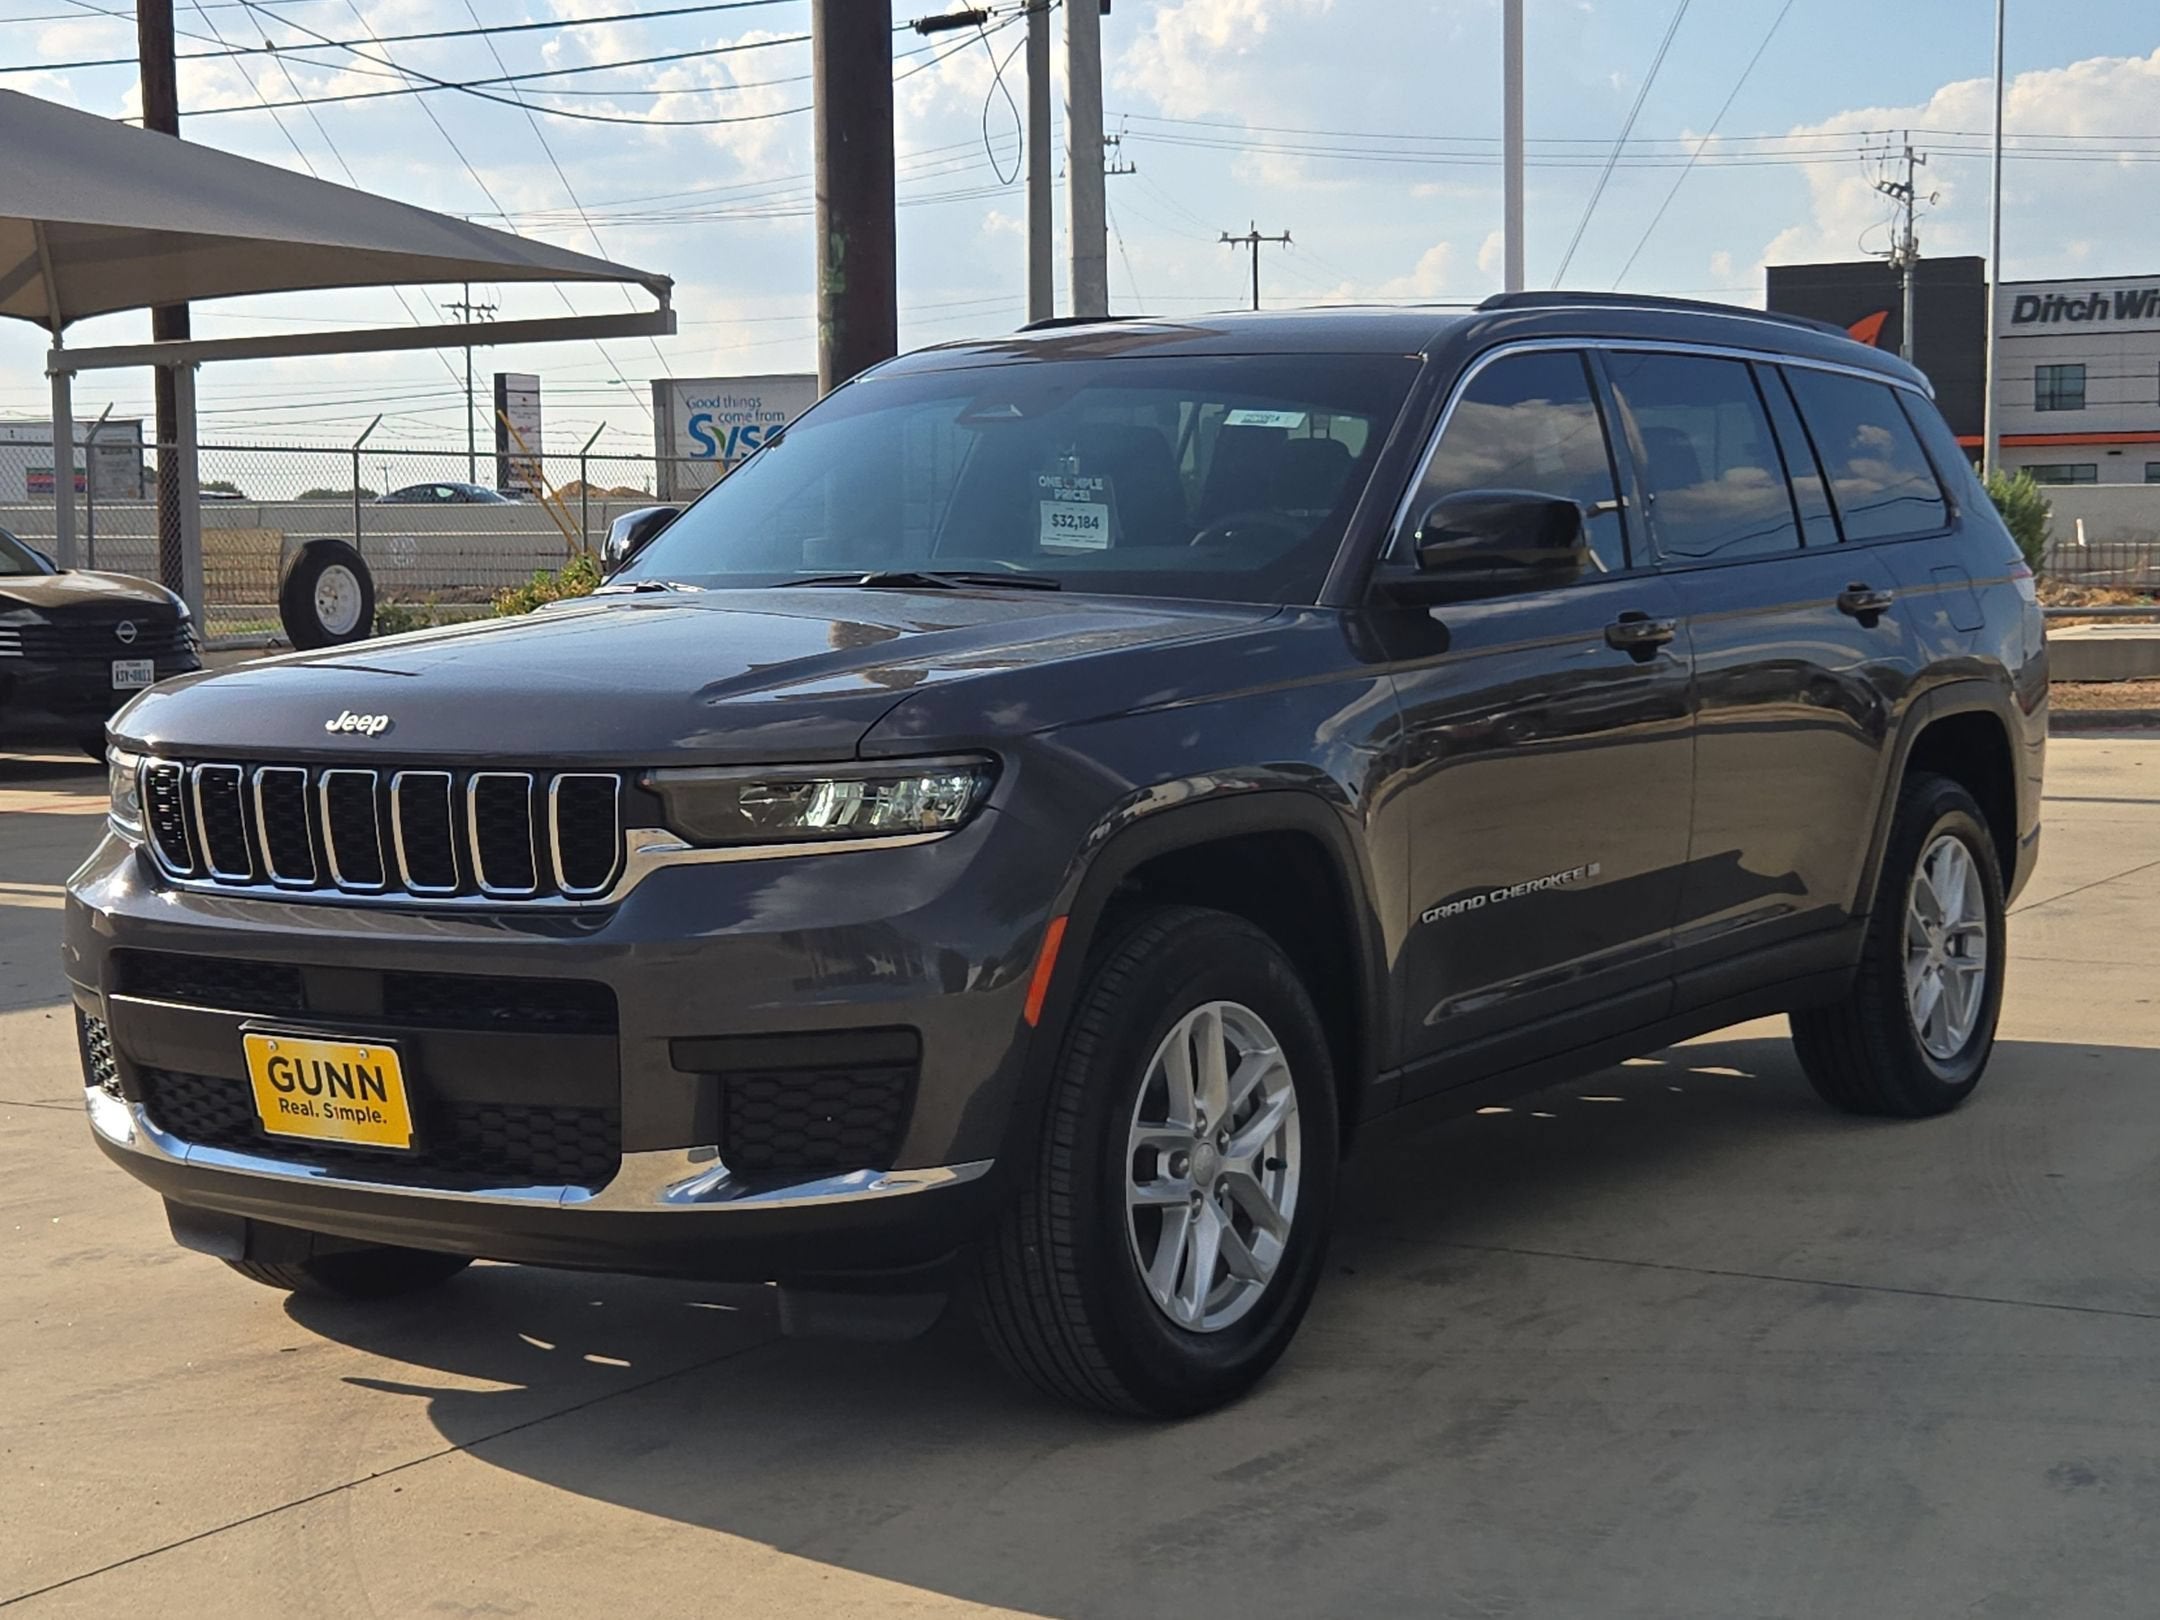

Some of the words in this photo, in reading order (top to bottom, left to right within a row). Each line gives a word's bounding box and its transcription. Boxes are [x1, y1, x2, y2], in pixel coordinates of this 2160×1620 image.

[2011, 291, 2110, 324] Ditch
[2114, 288, 2160, 320] Wi
[687, 395, 720, 409] Good
[723, 395, 762, 409] things
[718, 411, 753, 424] come
[755, 410, 785, 422] from
[1051, 513, 1099, 531] $32,184
[325, 710, 389, 735] Jeep
[1422, 895, 1486, 924] GRAND
[1490, 866, 1585, 903] CHEROKEE
[267, 1056, 388, 1103] GUNN
[278, 1097, 320, 1118] Real.
